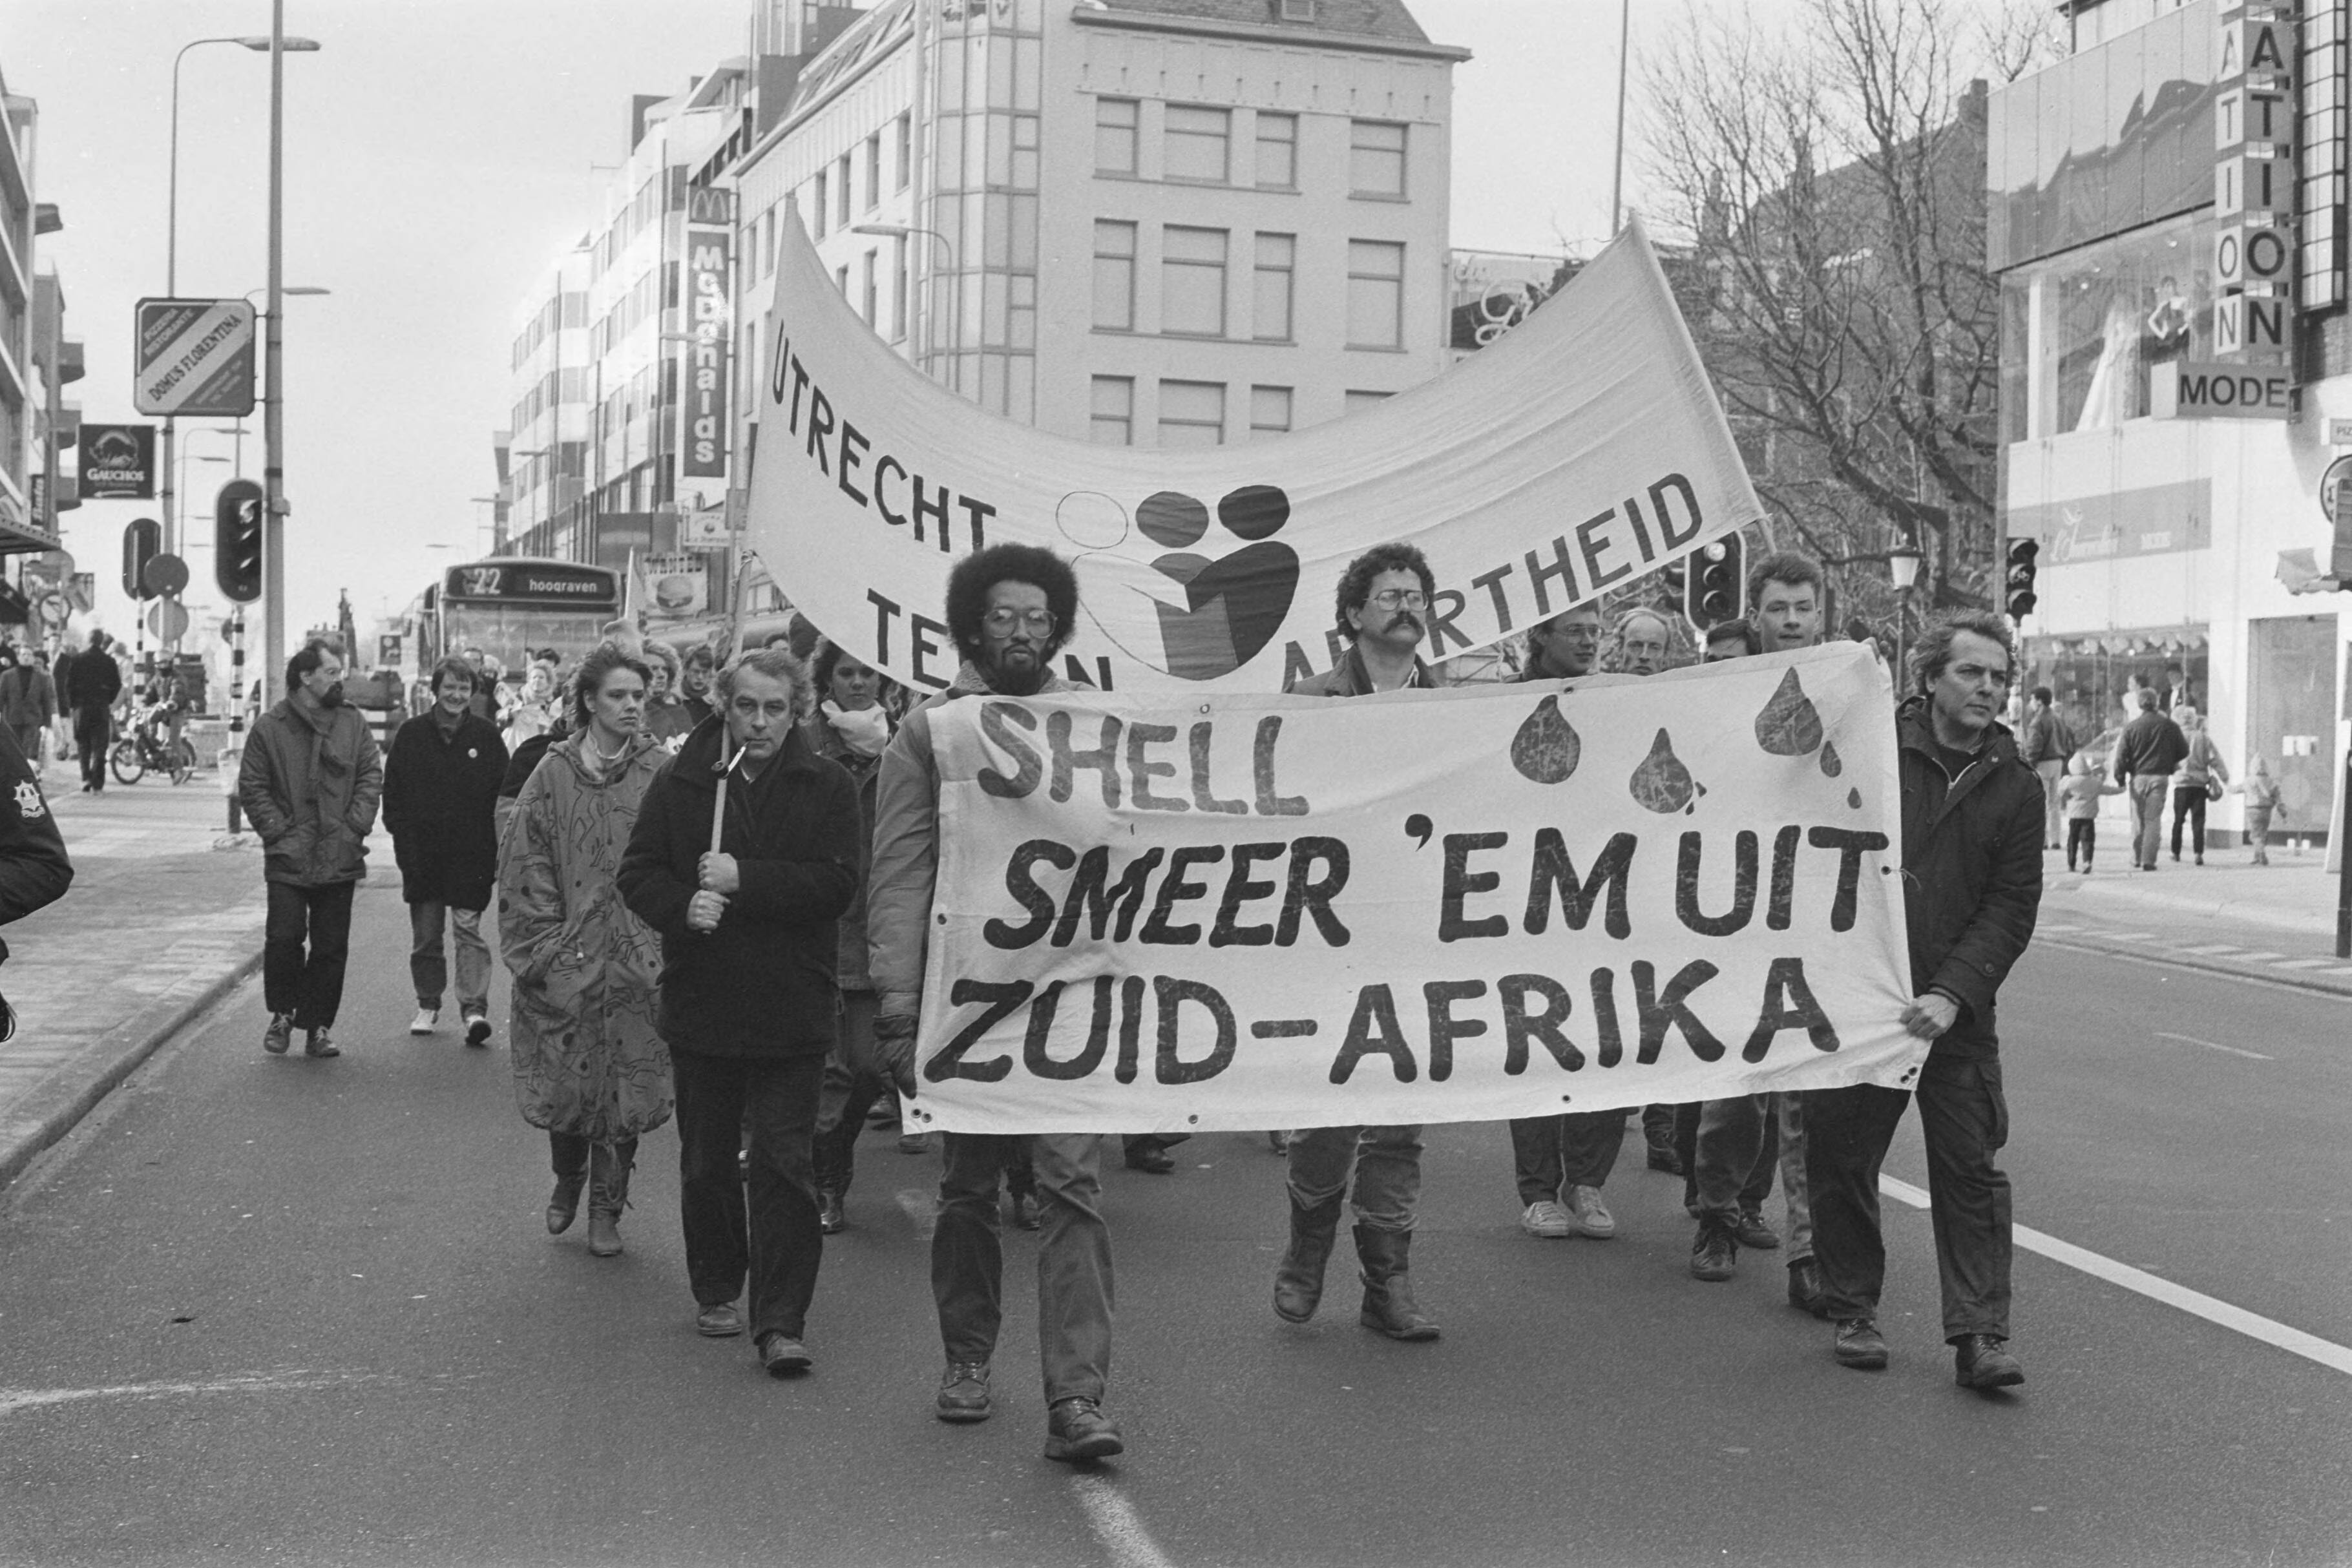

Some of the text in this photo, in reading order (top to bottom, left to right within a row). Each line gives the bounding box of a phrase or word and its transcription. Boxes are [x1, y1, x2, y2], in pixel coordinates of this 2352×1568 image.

[148, 365, 185, 401] DOMUS
[180, 313, 242, 371] FLORENTINA
[2179, 374, 2287, 408] MODE
[87, 468, 145, 482] GAUCHOS
[772, 319, 997, 554] UTRECHT
[474, 568, 597, 595] 22 hoograven
[977, 702, 1310, 816] SHELL
[983, 835, 1351, 950] SMEER
[1675, 824, 1889, 937] UIT
